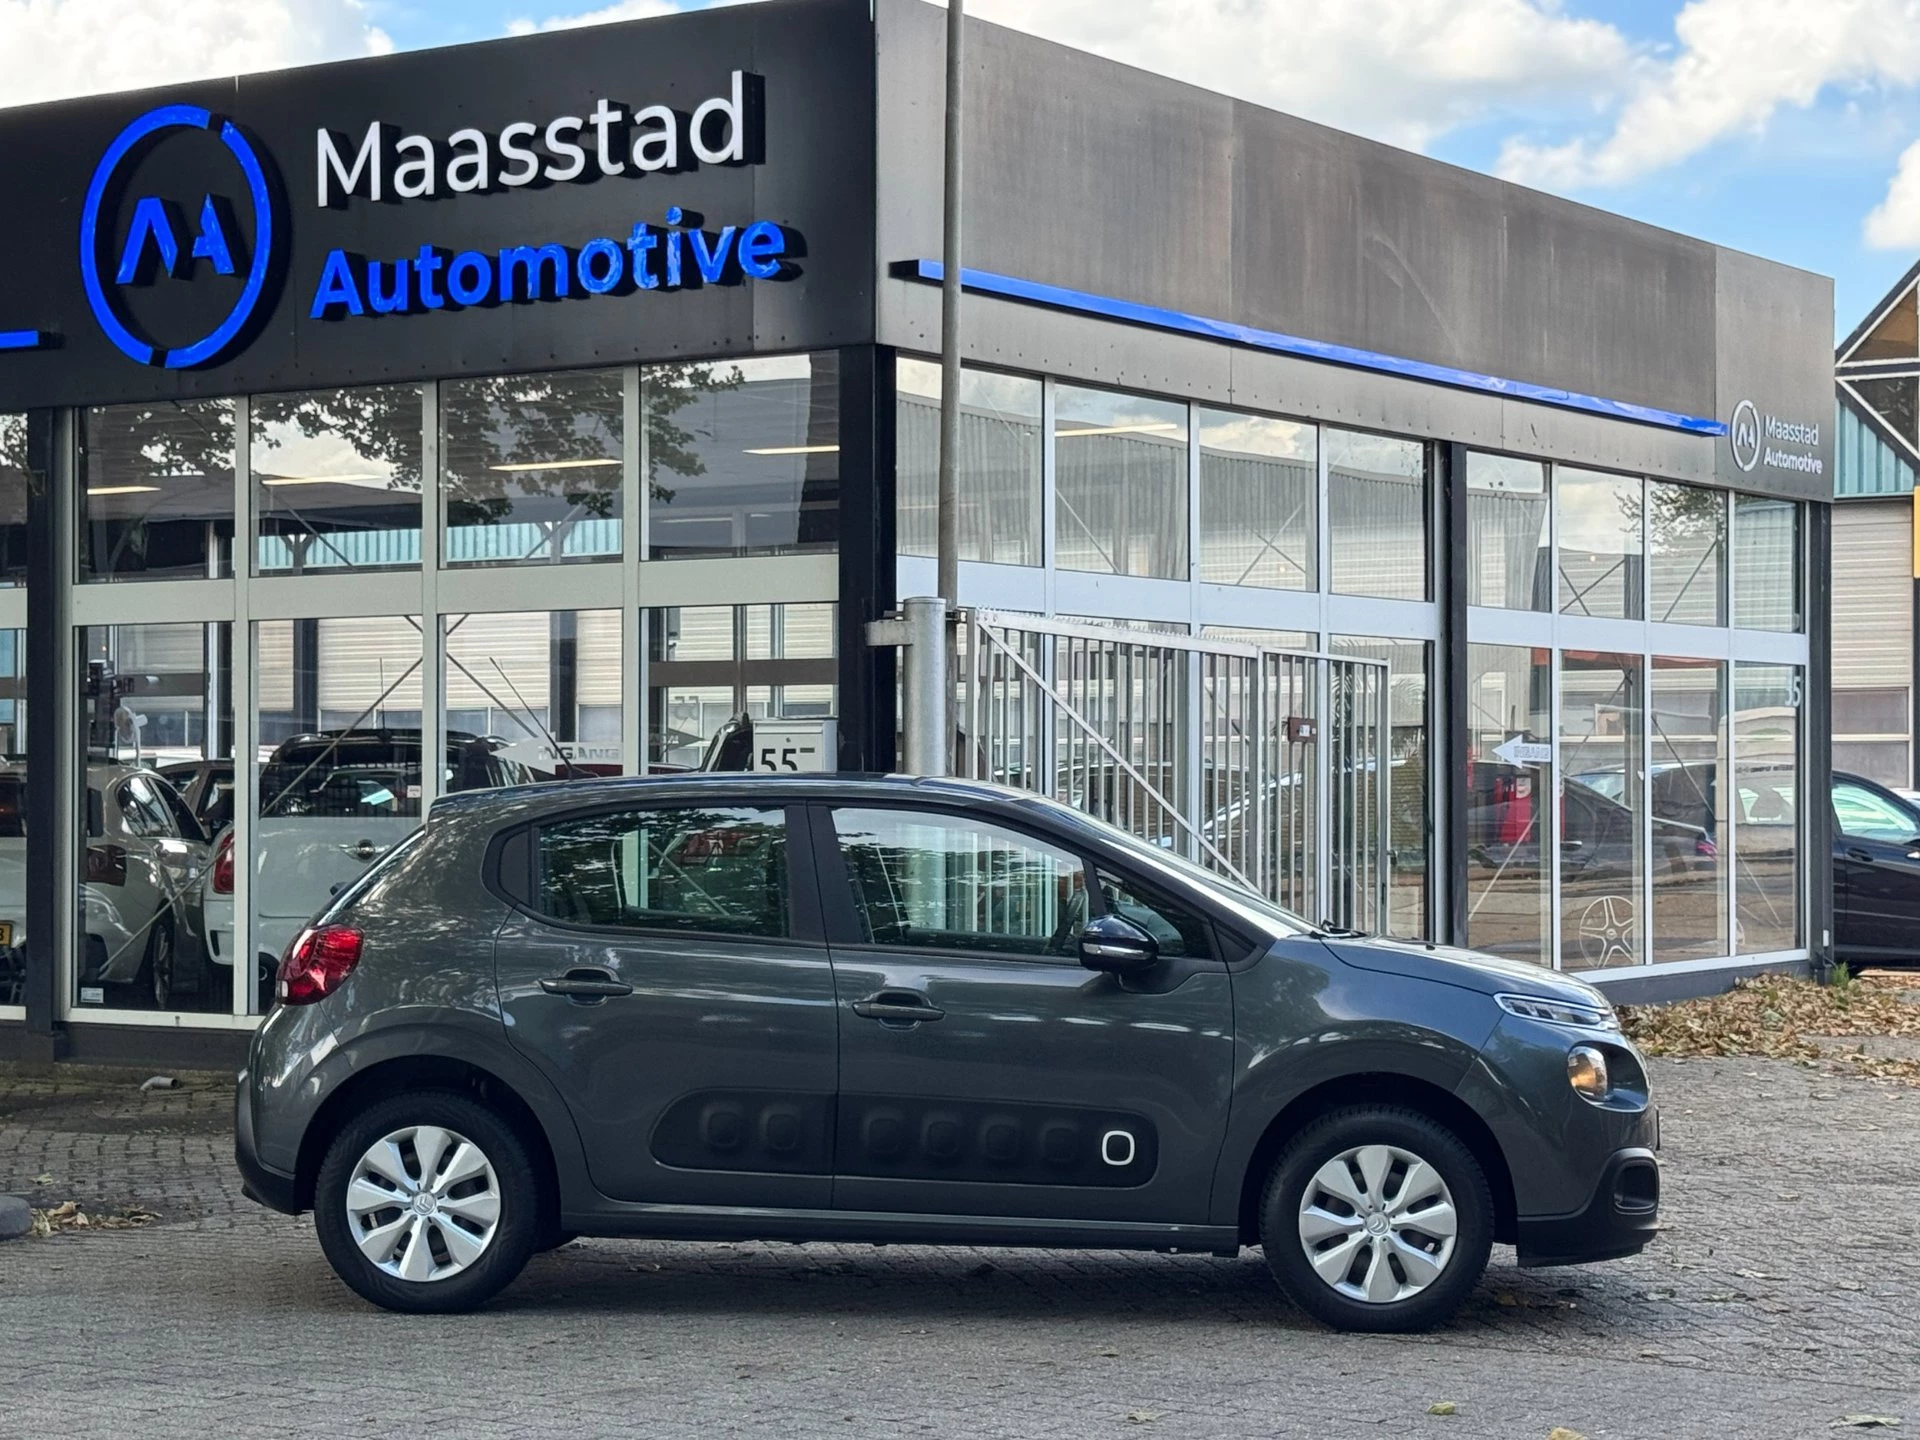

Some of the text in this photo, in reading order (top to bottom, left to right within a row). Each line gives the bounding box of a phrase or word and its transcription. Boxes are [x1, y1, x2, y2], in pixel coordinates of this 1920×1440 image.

[317, 70, 743, 207] Maasstad
[309, 206, 785, 318] Automotive
[1764, 414, 1818, 445] Maasstad
[1764, 446, 1823, 474] Automotive
